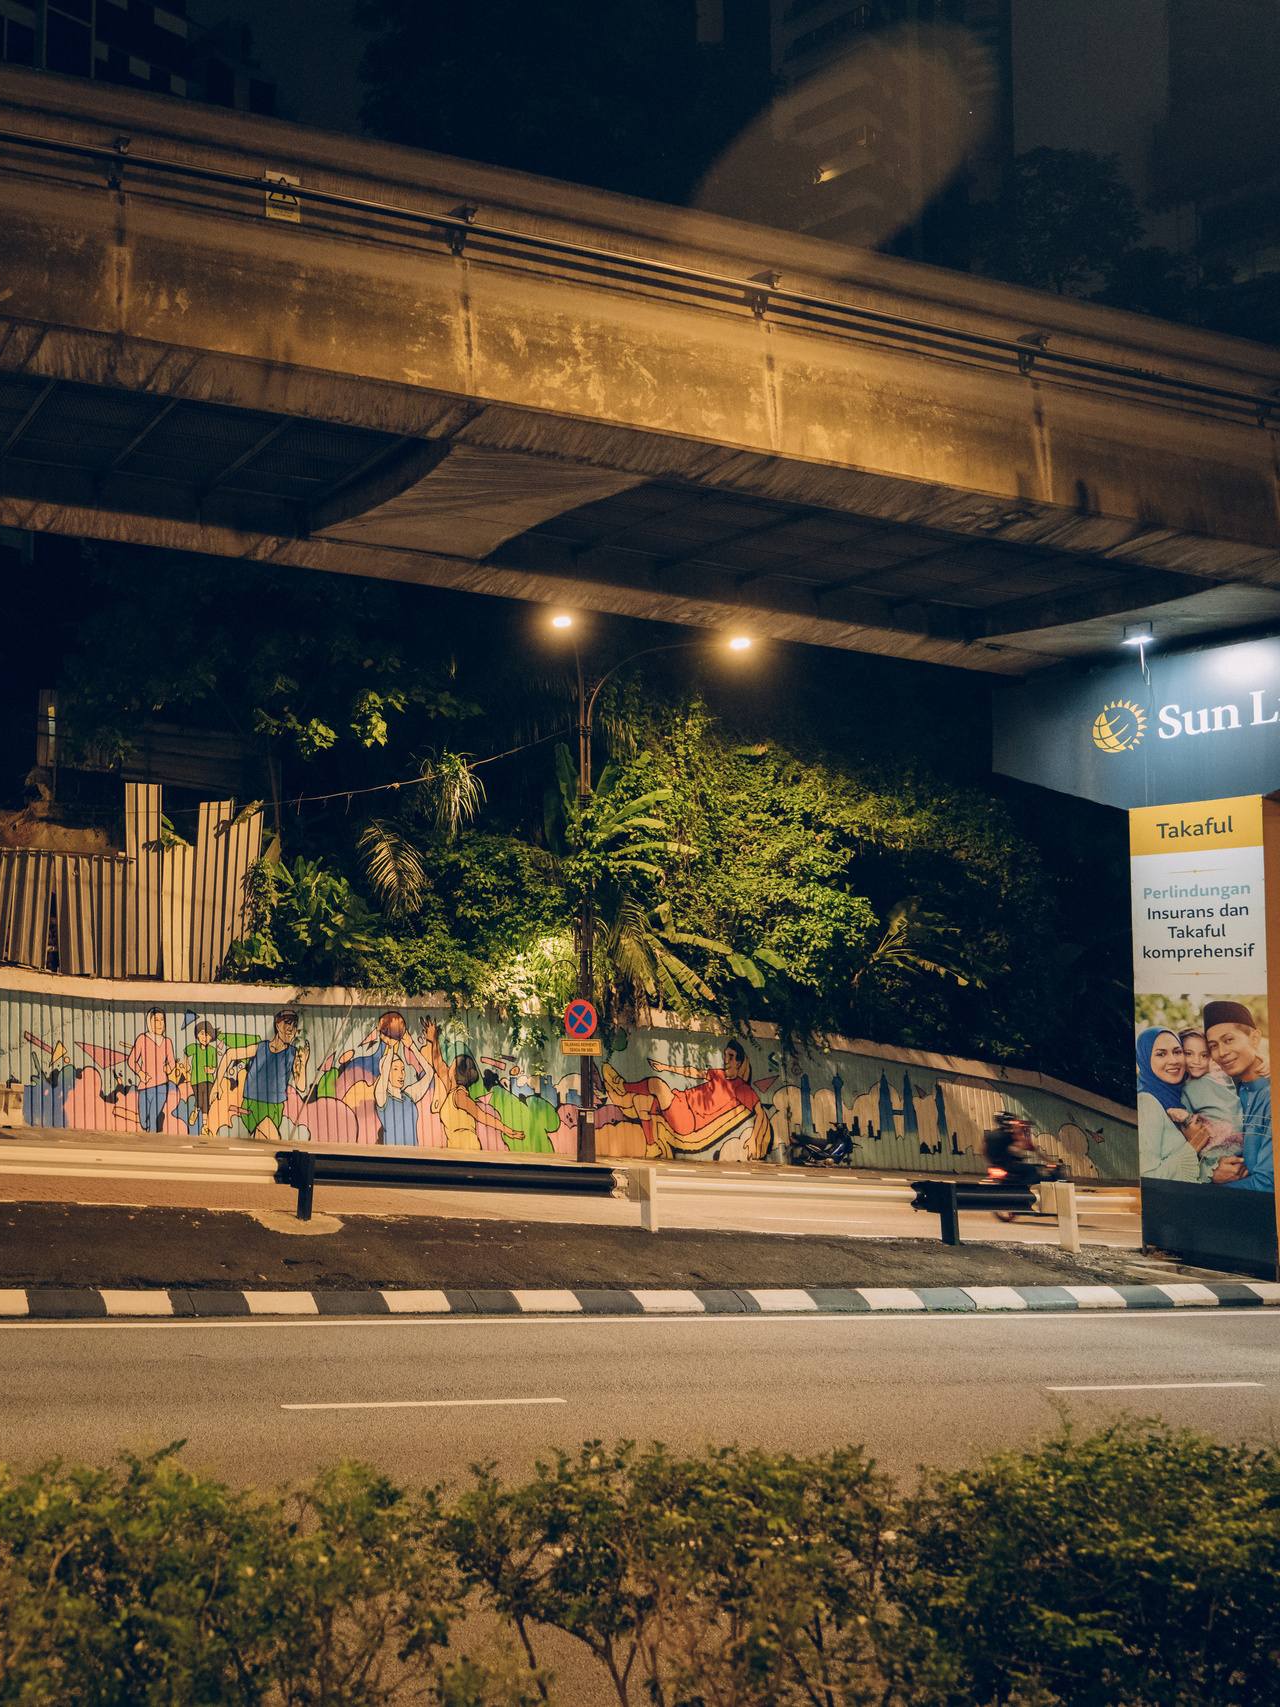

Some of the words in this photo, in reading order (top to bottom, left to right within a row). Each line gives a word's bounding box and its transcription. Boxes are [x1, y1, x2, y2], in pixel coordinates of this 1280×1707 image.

[1158, 704, 1242, 739] Sun
[1249, 690, 1280, 725] L
[1156, 815, 1233, 839] Takaful
[1143, 884, 1251, 900] Perlindungan
[1147, 907, 1214, 920] Insurans
[1219, 903, 1249, 917] dan
[1167, 923, 1226, 939] Takaful
[1142, 943, 1255, 962] komprehensif
